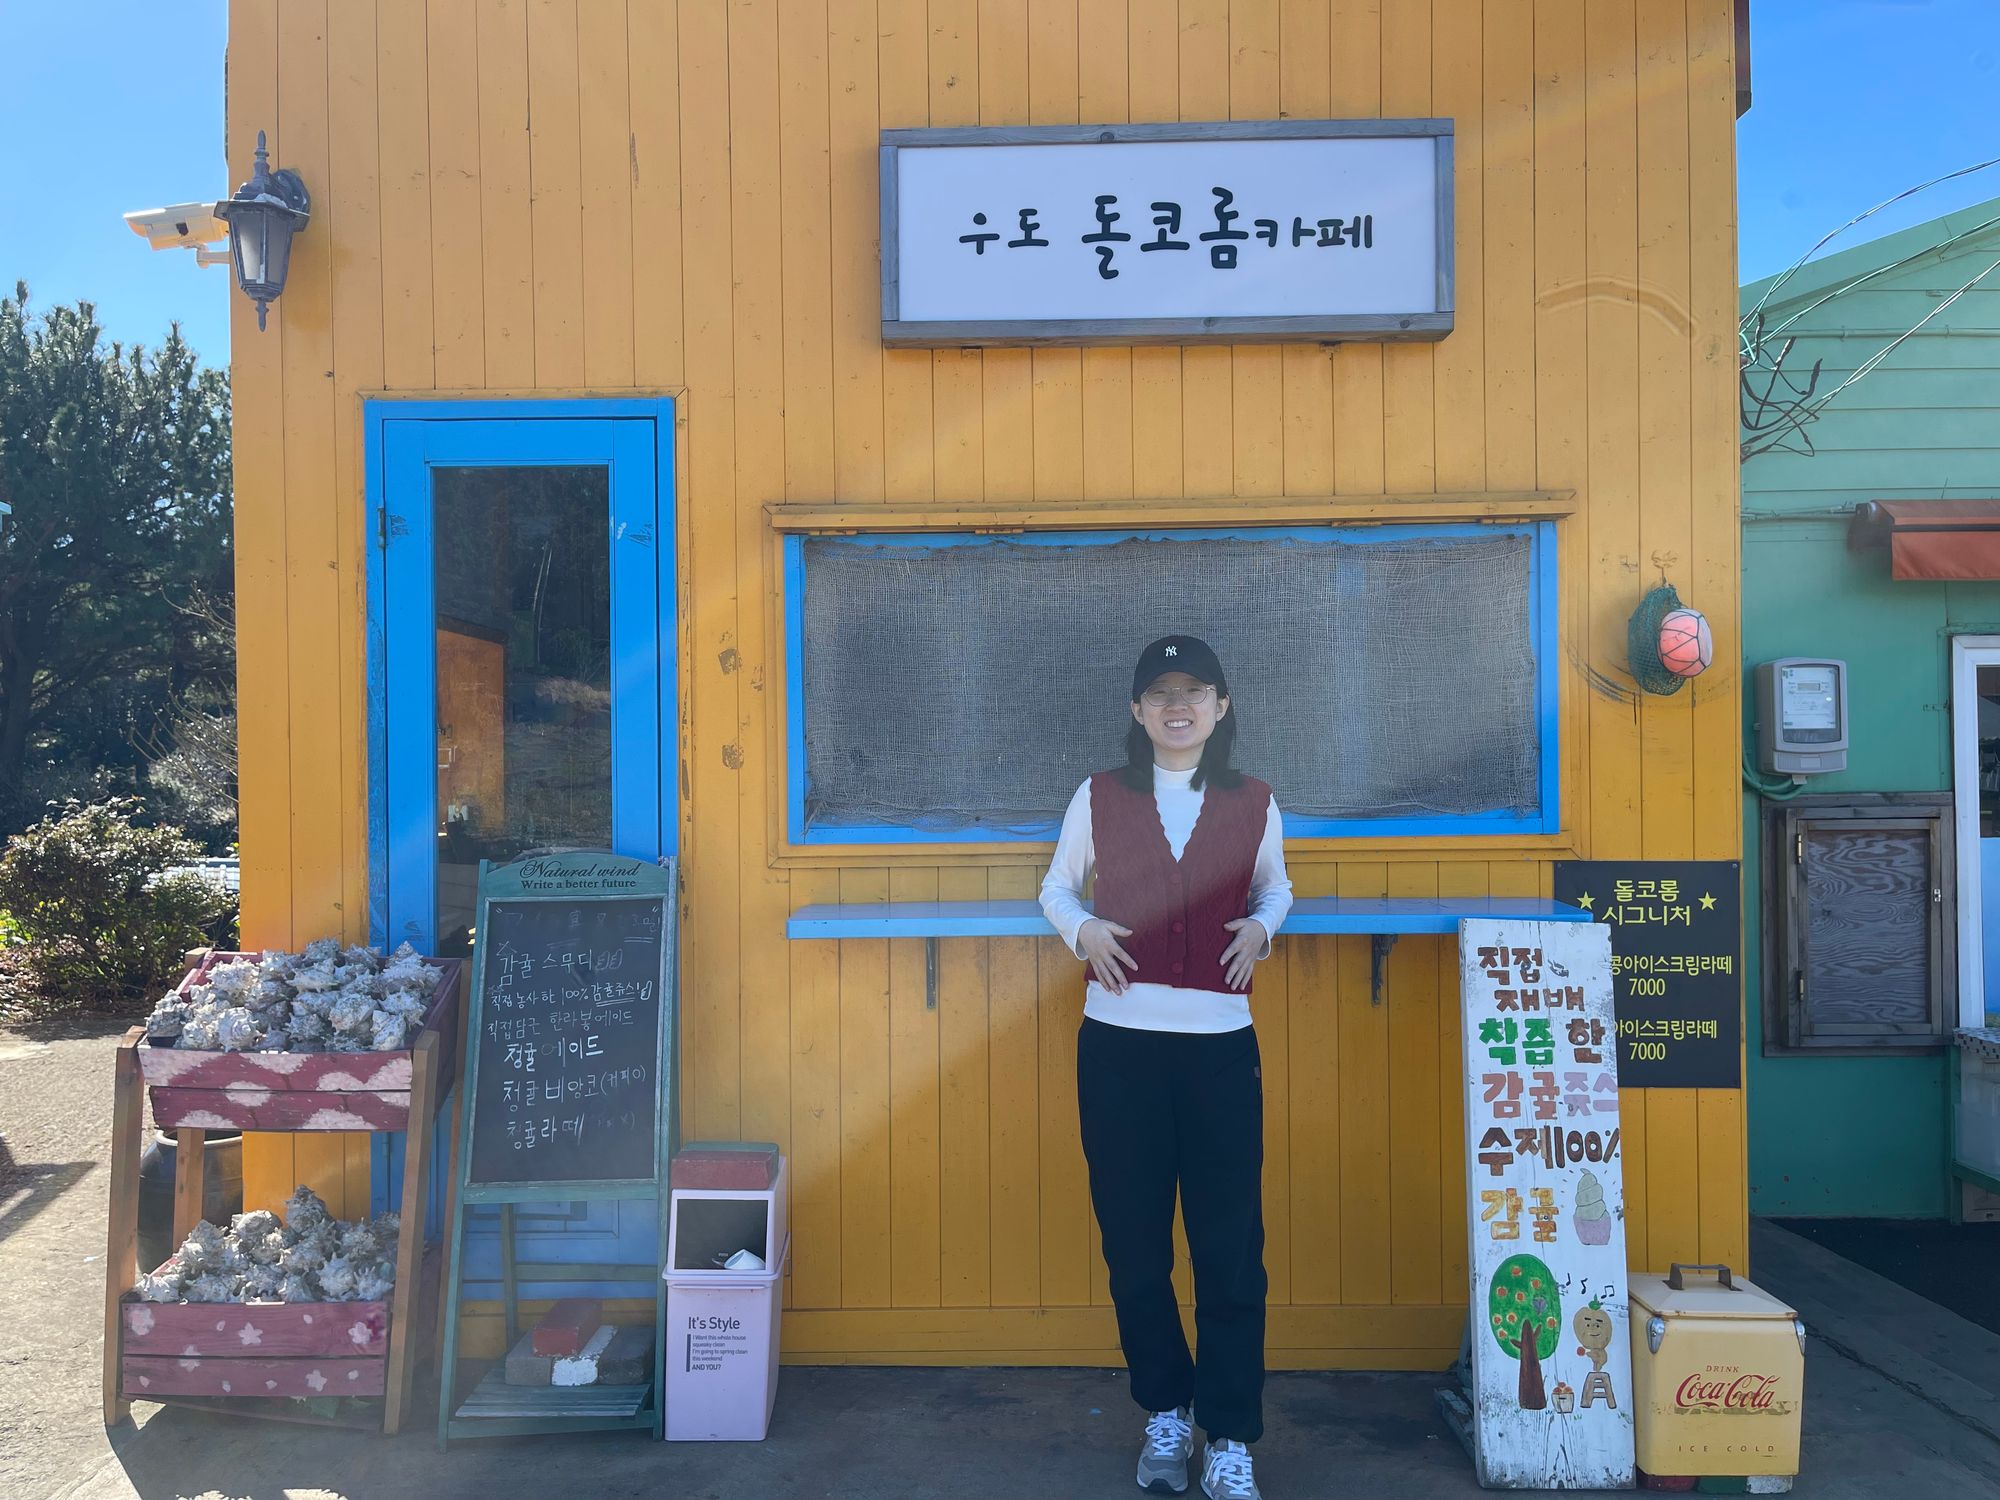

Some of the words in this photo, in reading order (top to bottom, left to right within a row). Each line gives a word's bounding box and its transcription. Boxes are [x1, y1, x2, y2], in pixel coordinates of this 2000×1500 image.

[958, 207, 1050, 256] 우도
[1165, 645, 1178, 657] NY
[519, 860, 598, 879] Natural
[597, 862, 642, 878] wind
[521, 879, 554, 889] Write
[556, 880, 563, 889] a
[565, 879, 600, 889] better
[601, 878, 637, 888] future
[1613, 879, 1680, 902] 돌코롬
[1602, 905, 1692, 926] 시그니처
[542, 948, 592, 974] 스무디
[1477, 946, 1543, 986] 직접
[1628, 978, 1666, 996] 7000
[1494, 986, 1586, 1012] 재배
[1628, 1042, 1666, 1061] 7000
[1480, 1187, 1560, 1243] 감귤
[688, 1316, 707, 1330] It's
[708, 1316, 741, 1333] Style
[691, 1363, 706, 1371] AND
[706, 1363, 722, 1371] YOU?
[1705, 1365, 1740, 1373] DRINK
[1678, 1445, 1709, 1453] ICE
[1726, 1445, 1775, 1453] COLD
